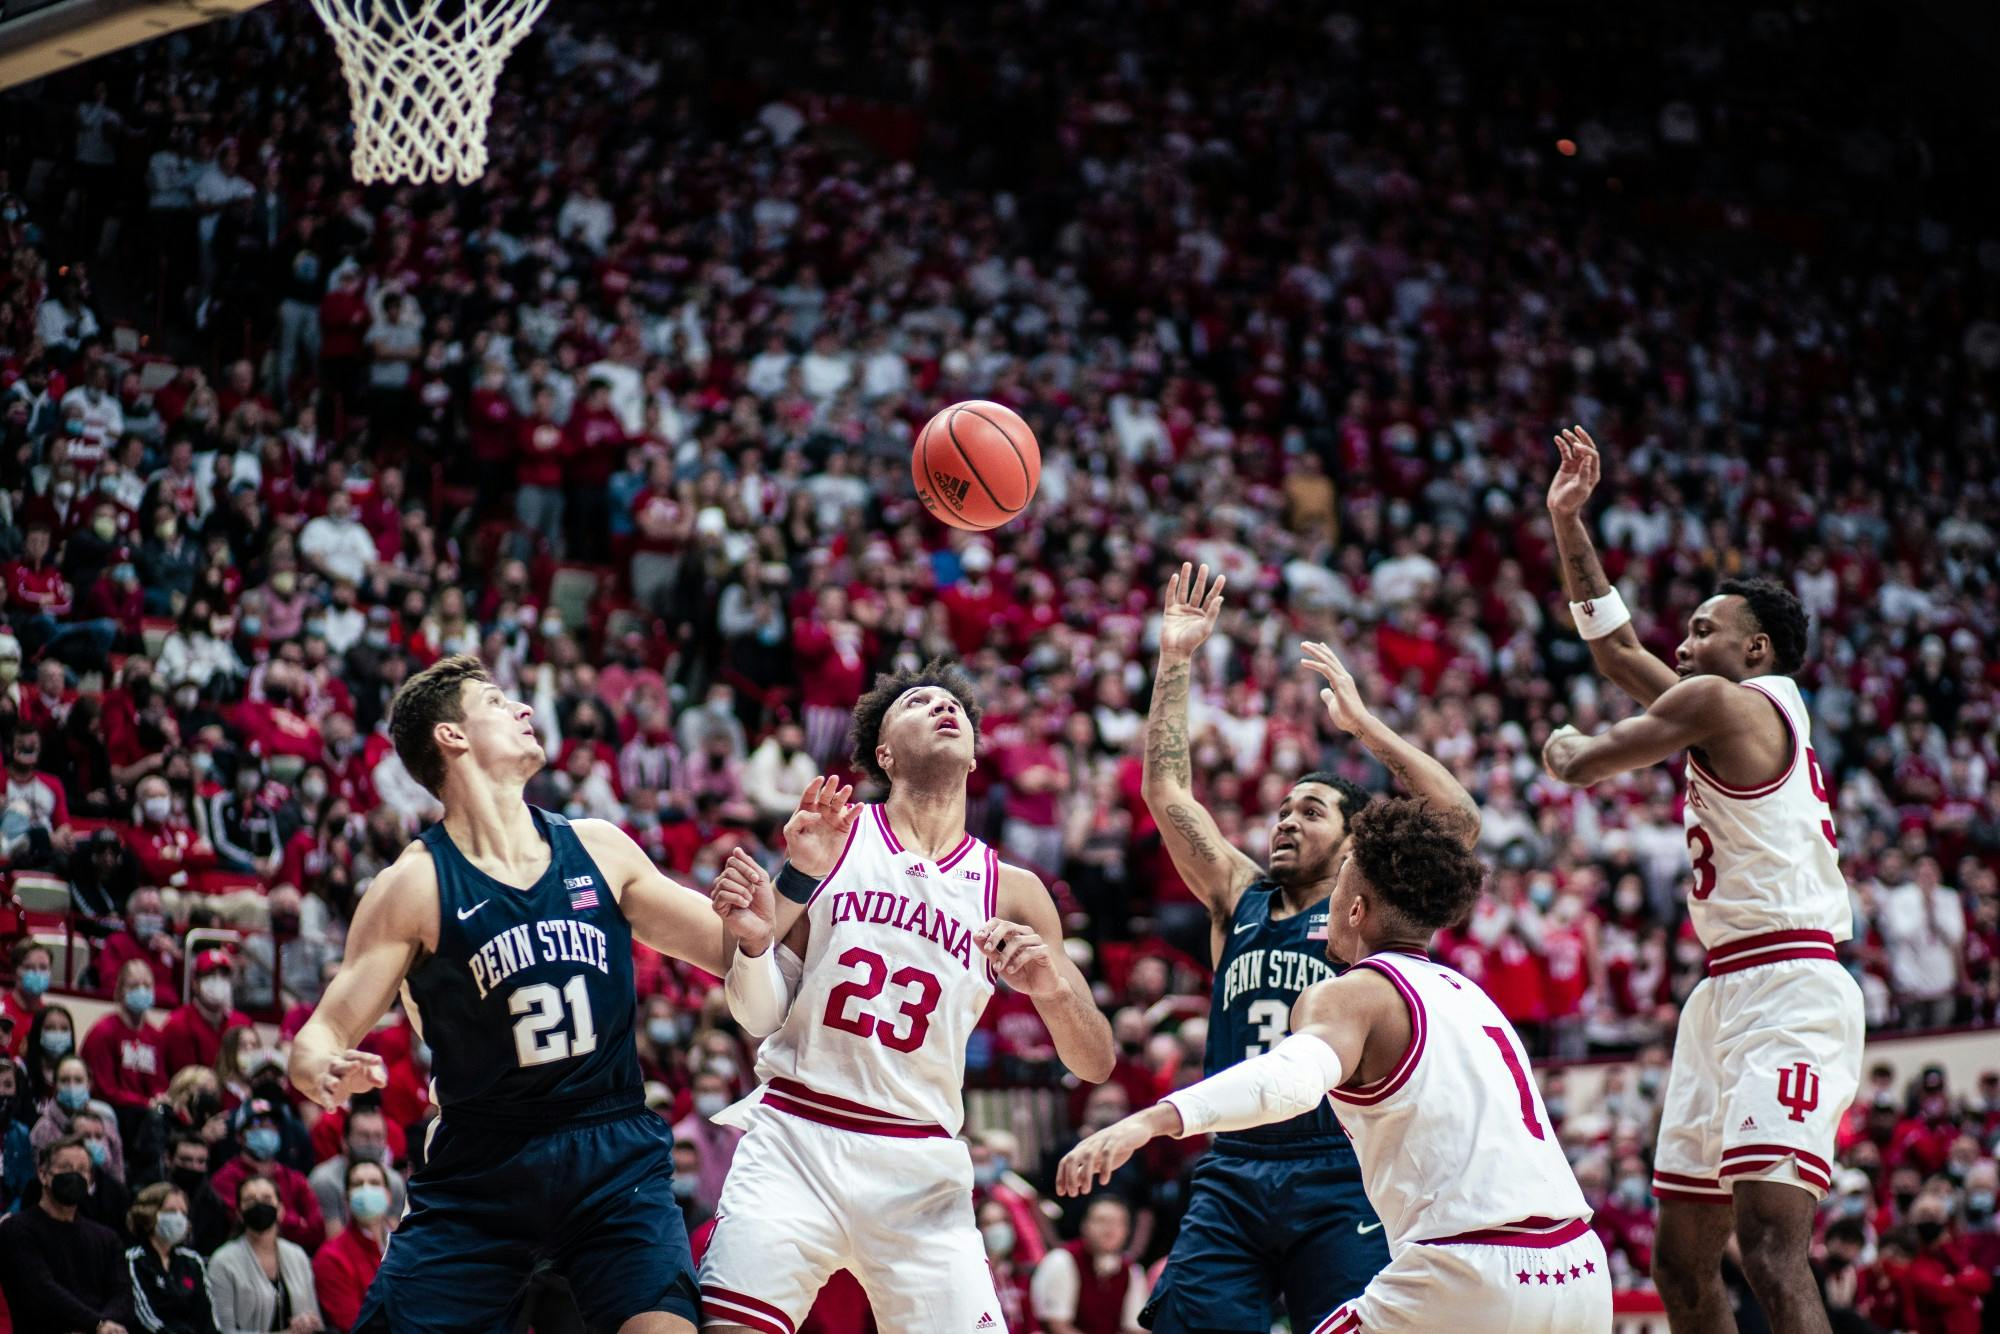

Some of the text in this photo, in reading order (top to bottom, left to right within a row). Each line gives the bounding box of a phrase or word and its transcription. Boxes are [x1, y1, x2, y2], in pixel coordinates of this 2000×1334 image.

[935, 472, 964, 511] adidas
[564, 876, 593, 890] BIG
[468, 919, 608, 1000] PENN STATE
[832, 890, 973, 970] INDIANA
[823, 946, 943, 1053] 23
[1223, 949, 1337, 1012] PENN STAT
[507, 974, 598, 1068] 21
[1245, 999, 1290, 1060] 3
[1482, 1025, 1545, 1141] 1
